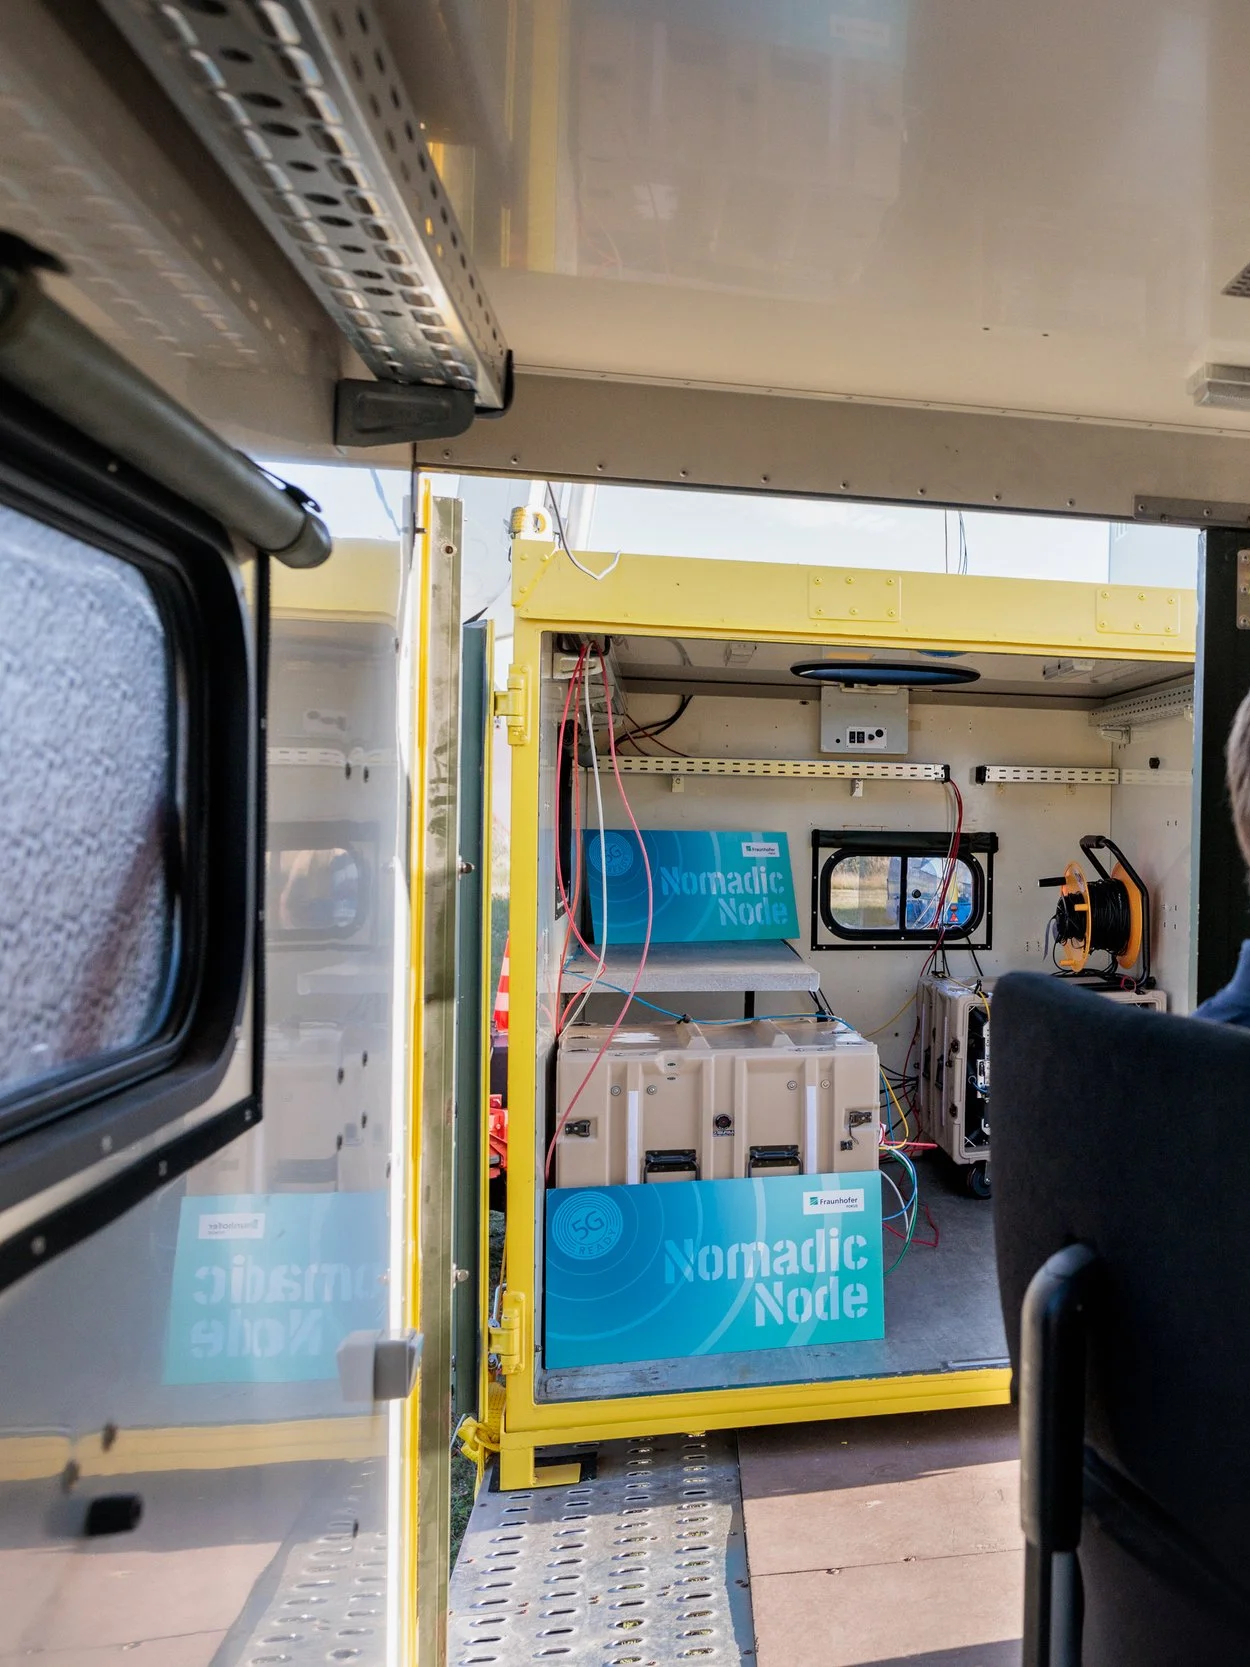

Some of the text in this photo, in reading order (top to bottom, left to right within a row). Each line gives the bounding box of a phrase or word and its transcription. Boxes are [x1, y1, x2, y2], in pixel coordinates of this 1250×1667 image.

[660, 866, 785, 895] Nomadic
[718, 897, 788, 926] Node
[820, 1196, 858, 1205] Fraunhofer
[571, 1210, 605, 1240] 5G
[579, 1228, 616, 1254] READY
[664, 1227, 869, 1284] Nomadic
[755, 1276, 869, 1327] Node
